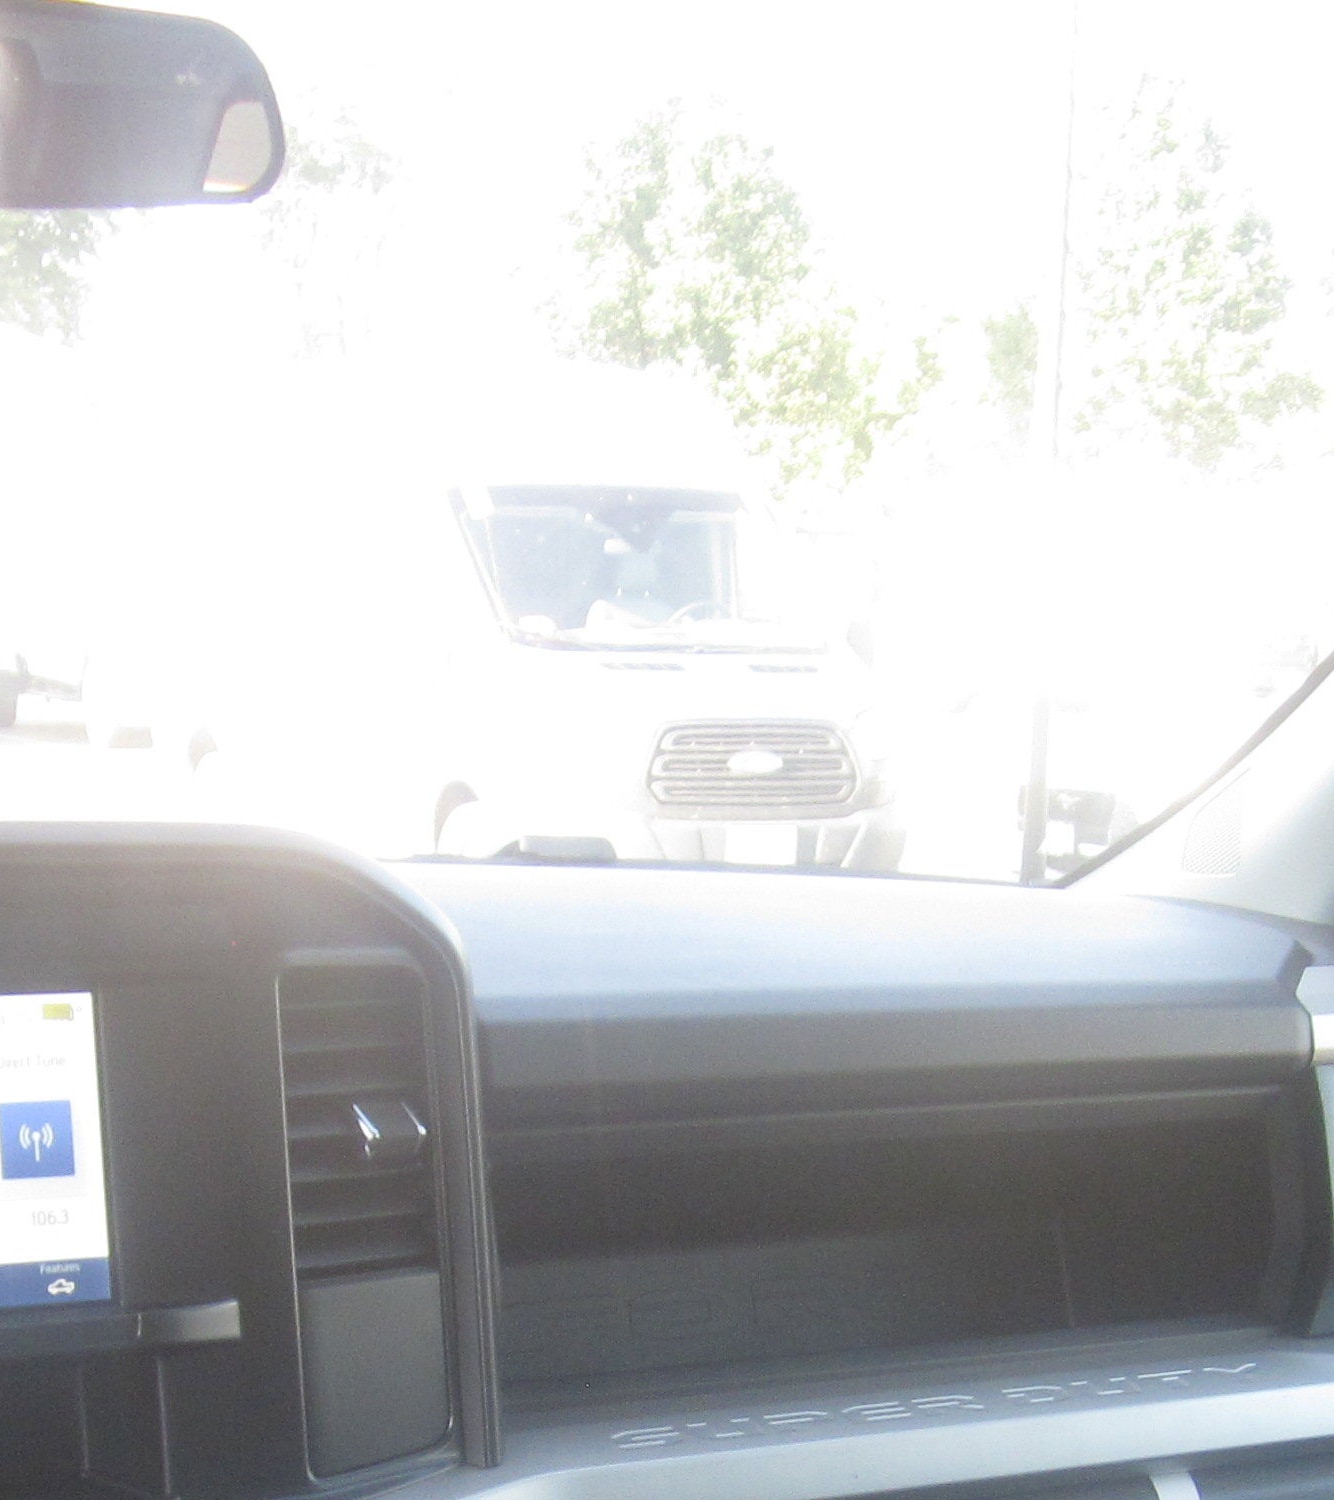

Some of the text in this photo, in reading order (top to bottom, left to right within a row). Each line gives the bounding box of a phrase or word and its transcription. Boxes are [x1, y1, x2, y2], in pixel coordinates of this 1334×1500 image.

[30, 1208, 70, 1227] 106.3
[40, 1263, 81, 1275] Features
[611, 1362, 1257, 1449] SUPER DUTY
